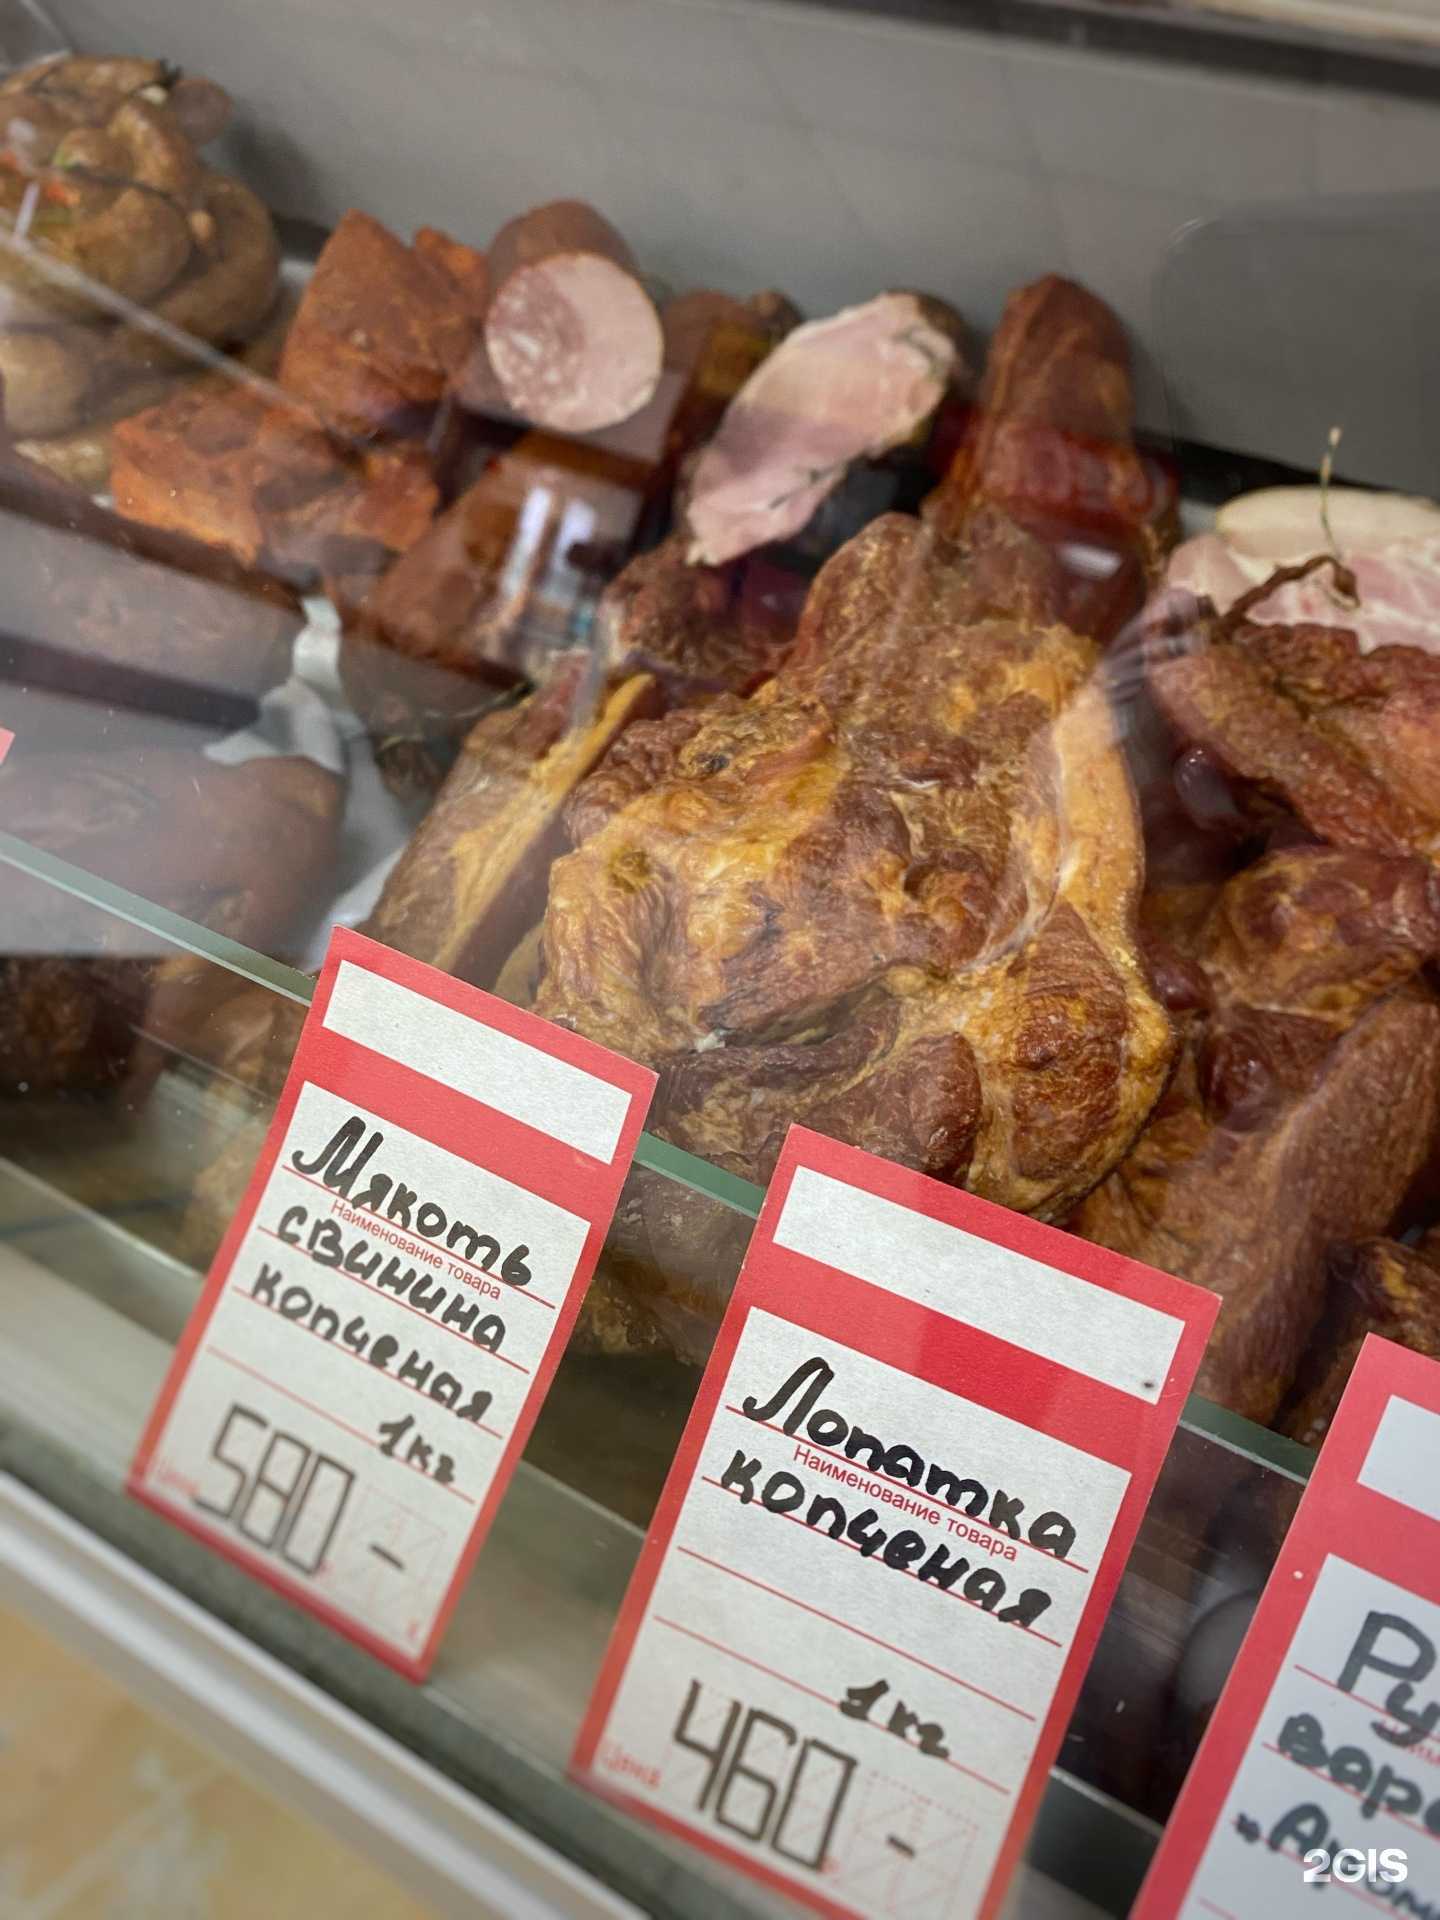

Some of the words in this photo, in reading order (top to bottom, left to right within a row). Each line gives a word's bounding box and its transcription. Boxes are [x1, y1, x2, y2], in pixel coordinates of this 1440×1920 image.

[277, 1206, 506, 1353] свинина
[292, 1116, 532, 1286] Мякоть
[330, 1199, 444, 1268] Наименование
[447, 1262, 502, 1300] товара
[252, 1263, 493, 1422] копченая
[193, 1402, 356, 1576] 580
[721, 1450, 1053, 1628] копченая
[742, 1356, 1077, 1559] Лопатка
[792, 1445, 941, 1527] Наименование
[947, 1516, 1018, 1562] товара
[673, 1678, 859, 1872] 460
